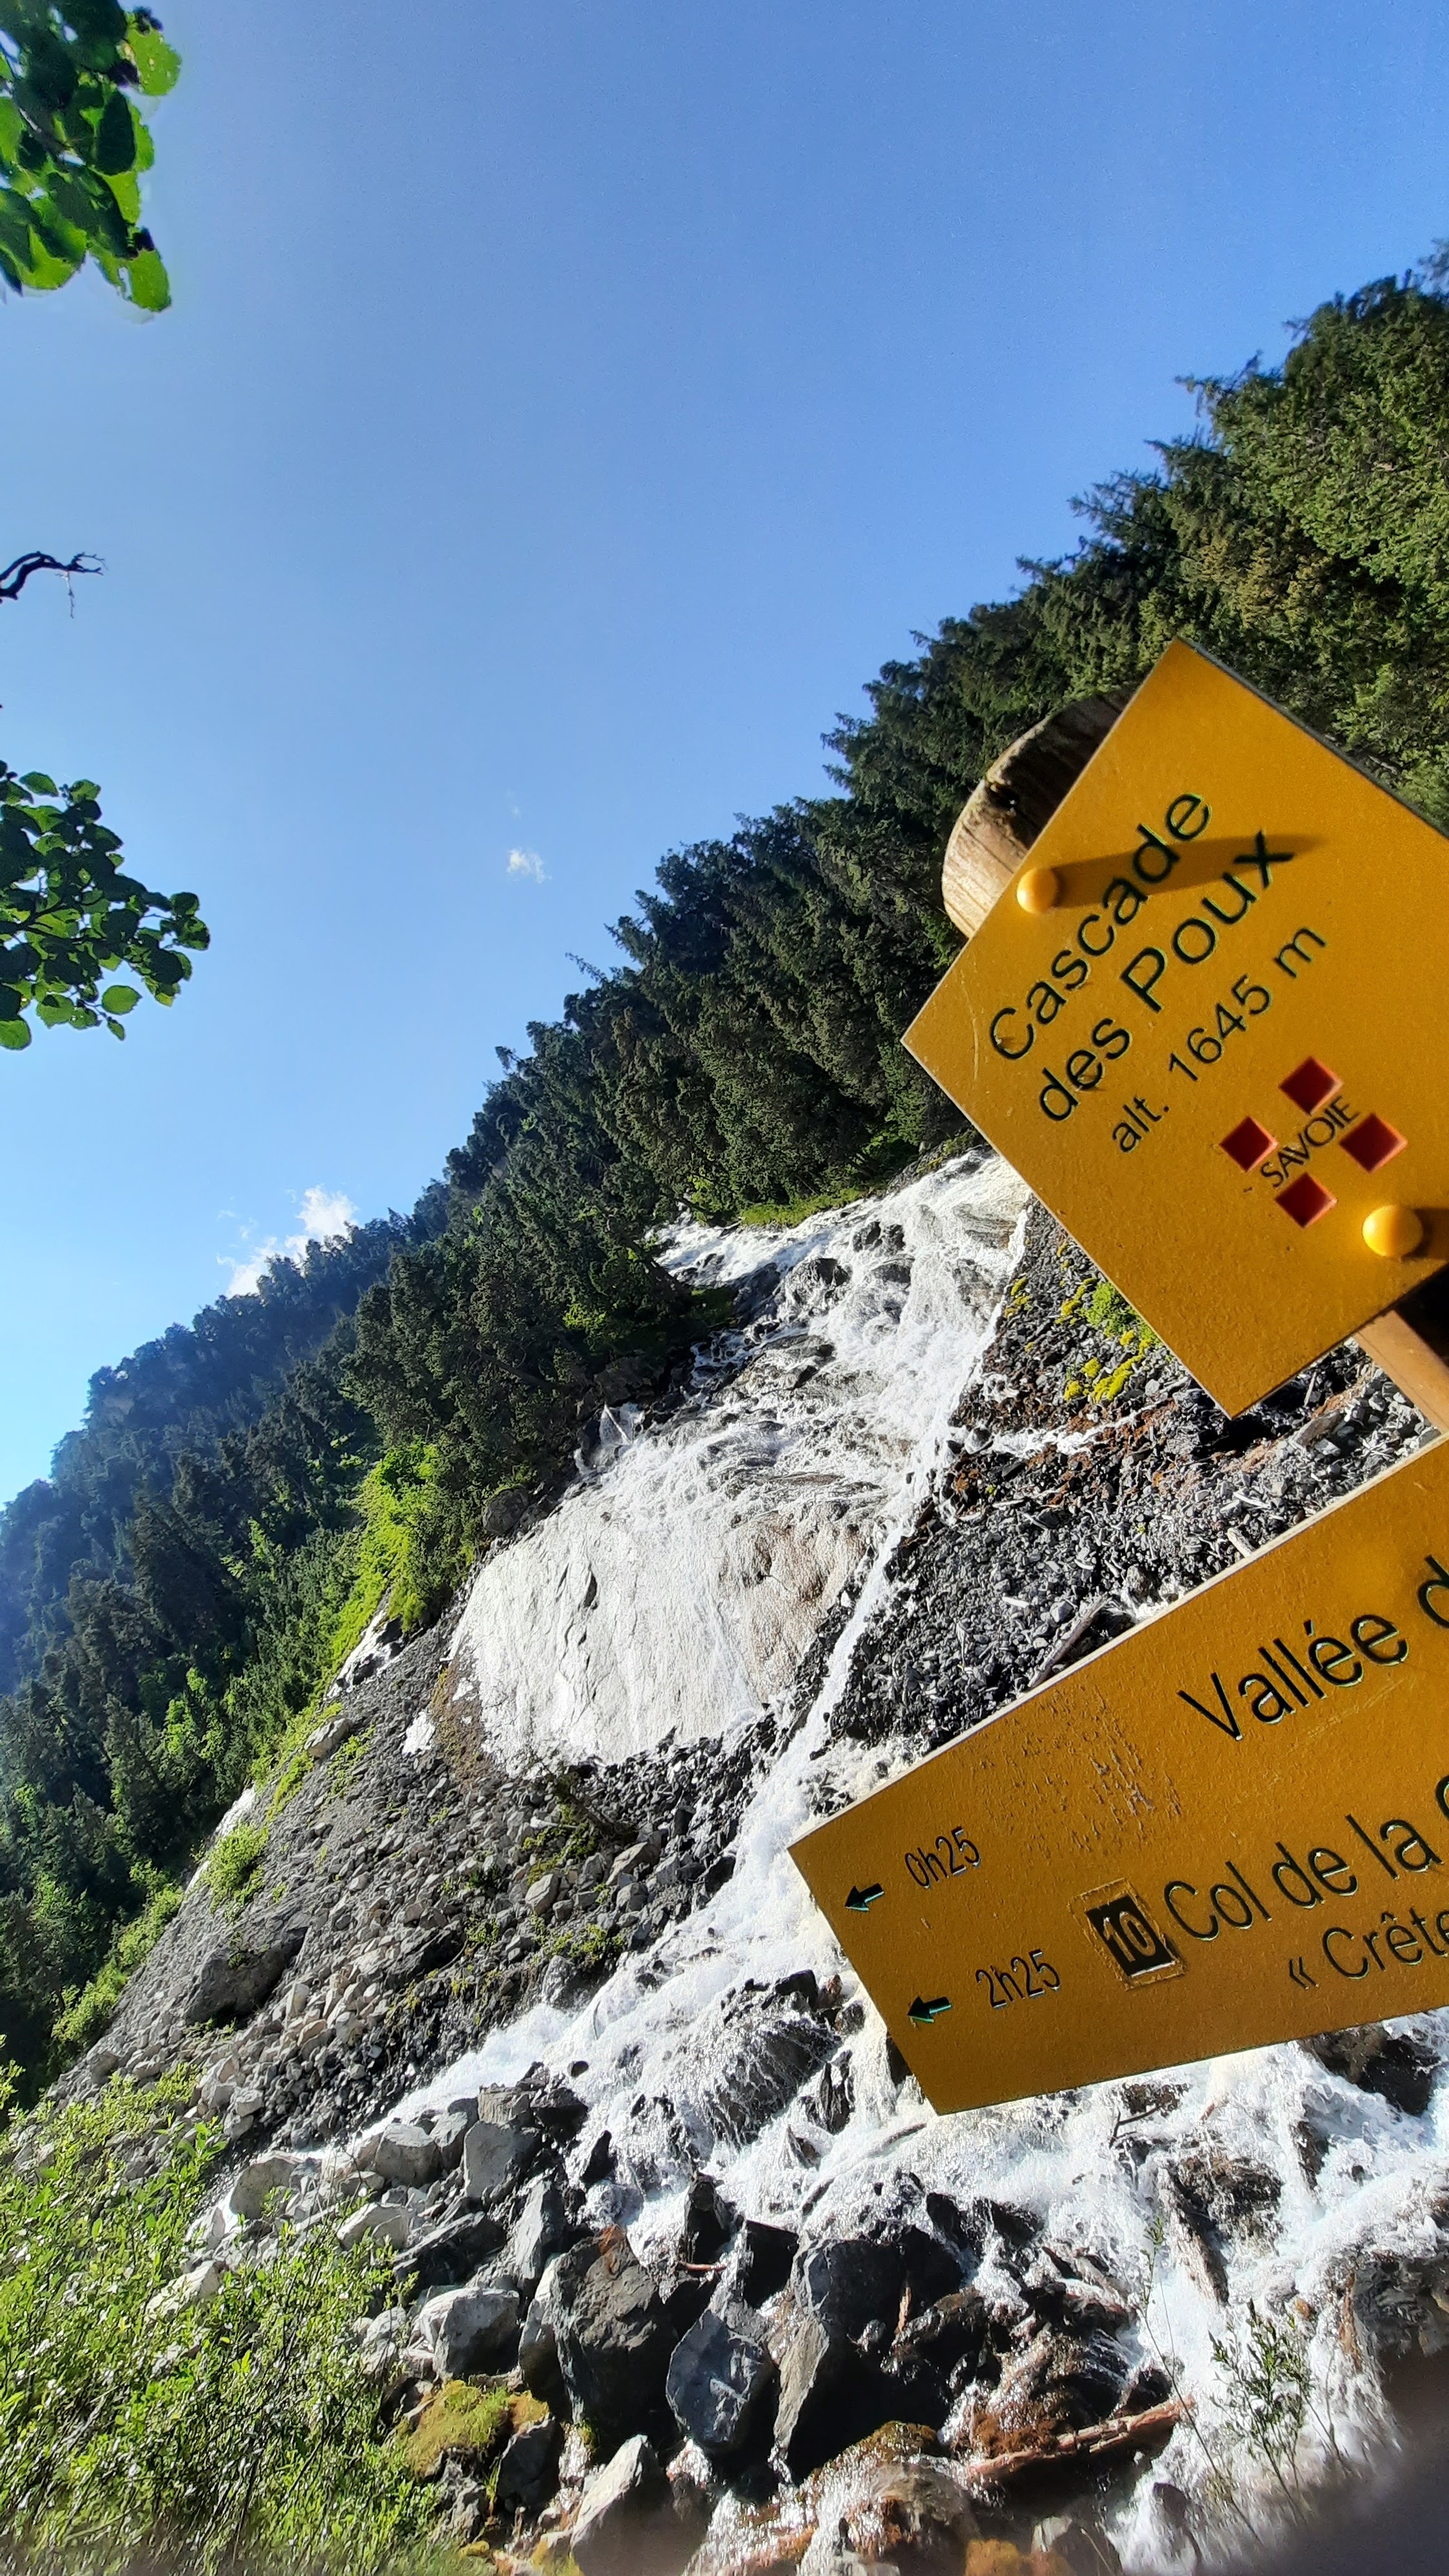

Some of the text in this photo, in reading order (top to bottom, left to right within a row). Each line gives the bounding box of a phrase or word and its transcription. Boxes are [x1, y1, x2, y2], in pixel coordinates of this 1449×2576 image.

[989, 792, 1212, 1061] Cascade
[1038, 829, 1295, 1122] des Poux
[1112, 926, 1327, 1153] alt. 1645 m
[1259, 1095, 1361, 1189] SAVOIE
[1176, 1613, 1410, 1741] Vallée
[905, 1826, 981, 1889] 0h25
[1164, 1814, 1445, 1942] Col de la
[975, 1948, 1061, 2009] 2h25
[1102, 1910, 1157, 1963] 10
